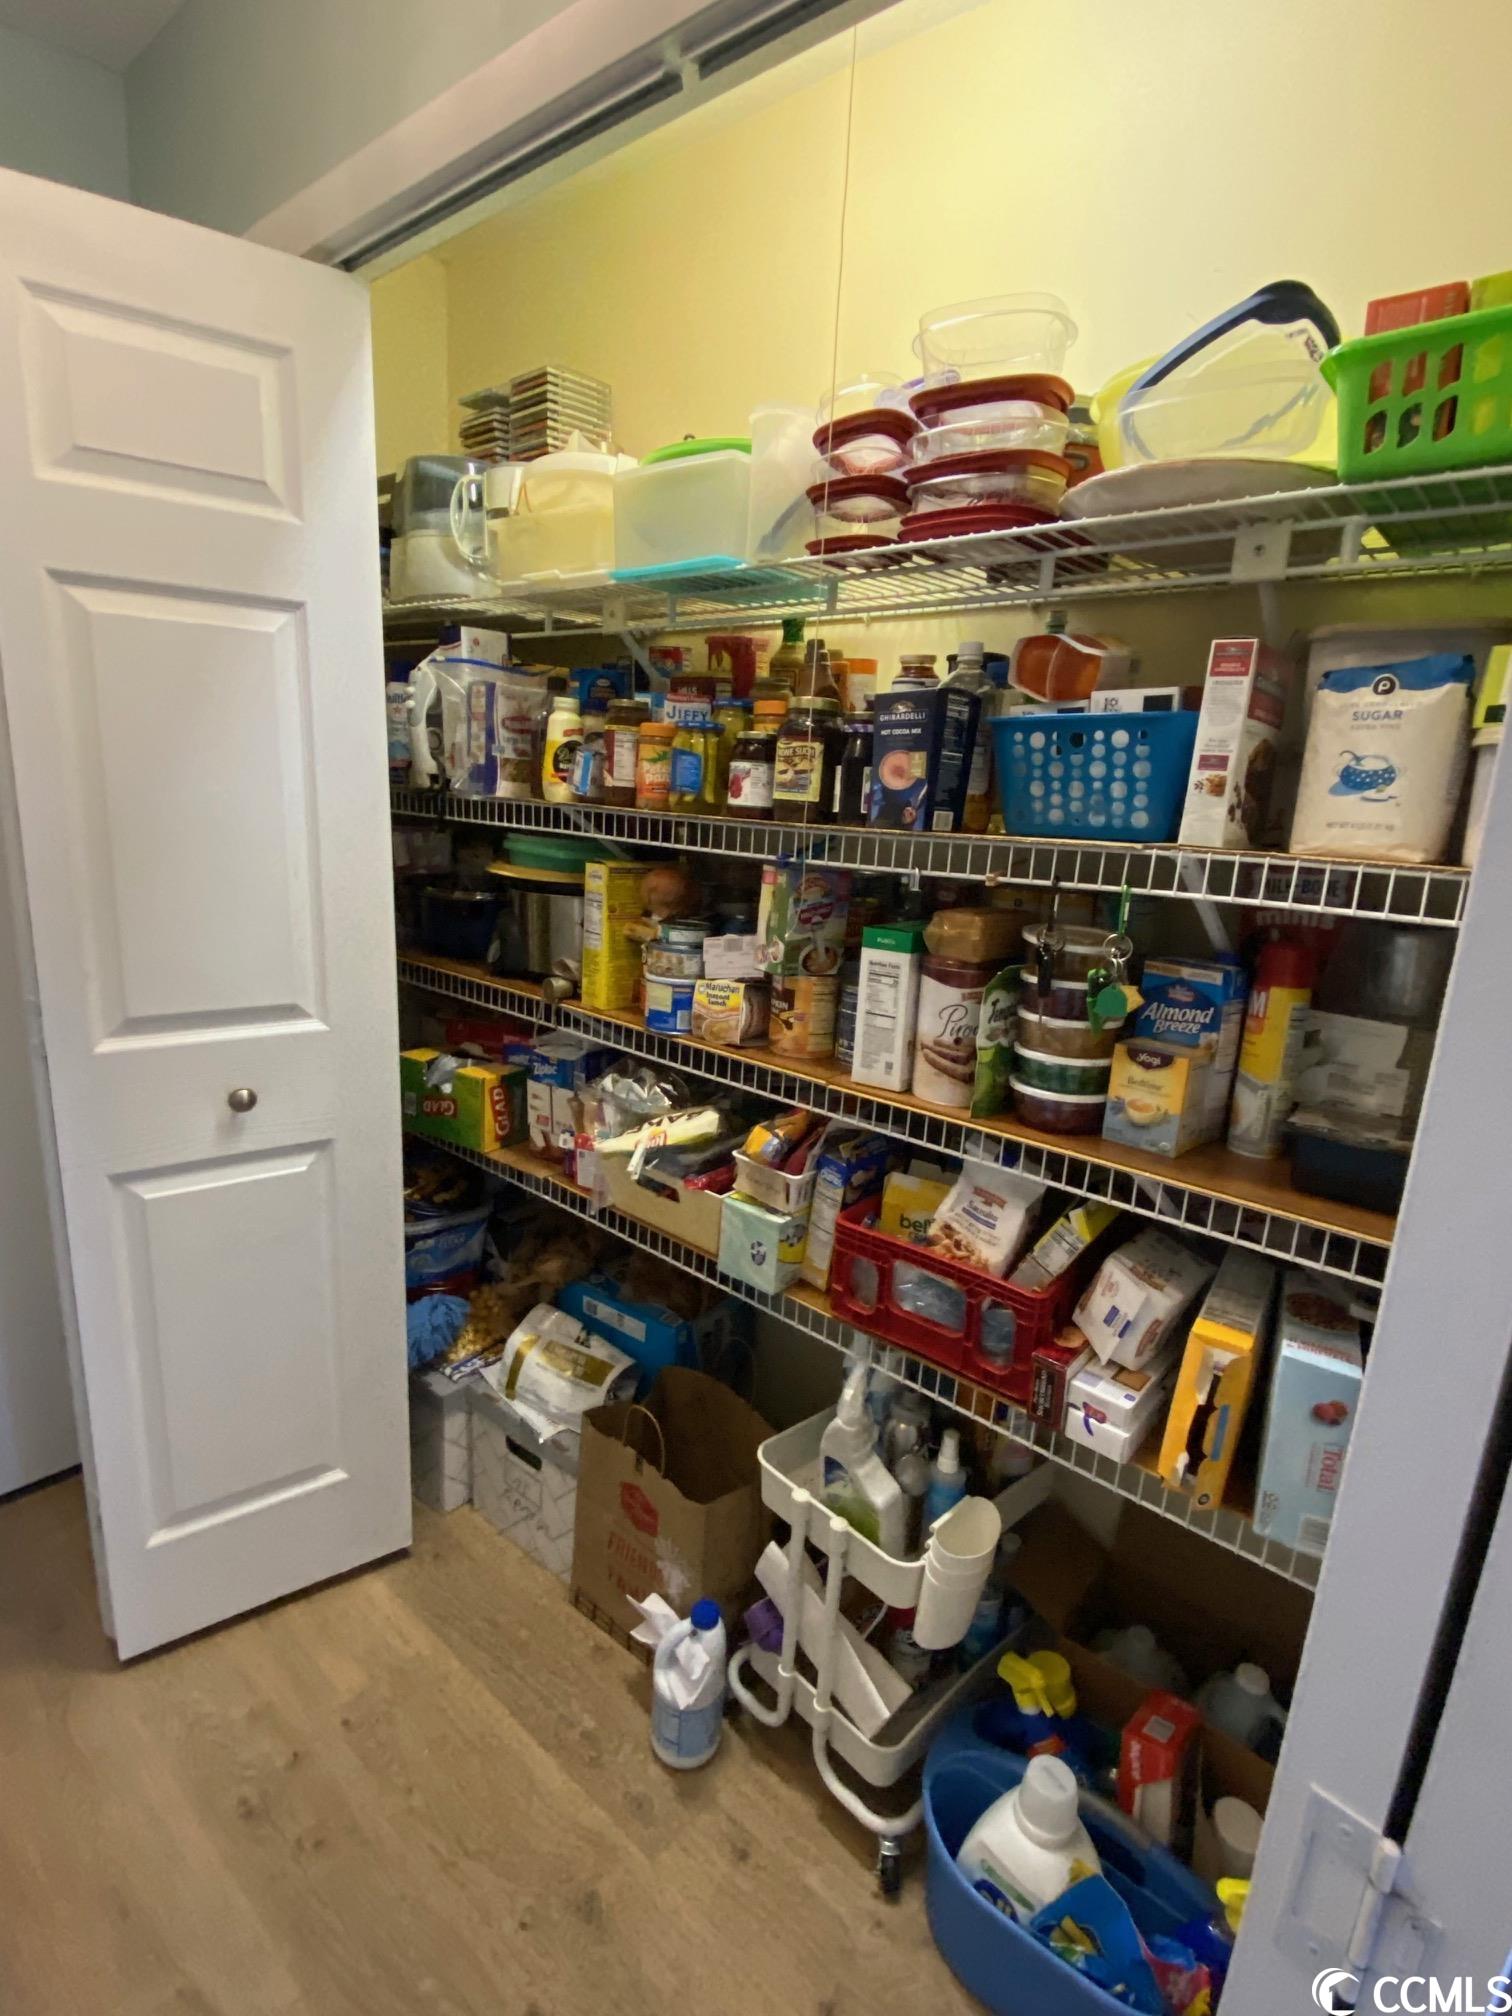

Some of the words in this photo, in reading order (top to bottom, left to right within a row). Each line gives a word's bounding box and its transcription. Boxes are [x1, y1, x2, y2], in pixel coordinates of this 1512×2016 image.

[666, 704, 708, 722] JIFFY
[879, 711, 926, 722] GHIRARDELLI
[1352, 709, 1403, 721] SUGAR
[880, 728, 892, 736] HOT
[892, 728, 910, 736] COCOA
[1140, 1000, 1214, 1025] Almond
[1152, 1018, 1201, 1035] Breeze
[423, 1099, 455, 1116] GLAD
[494, 1086, 511, 1136] GLAD
[1318, 1448, 1345, 1491] Total
